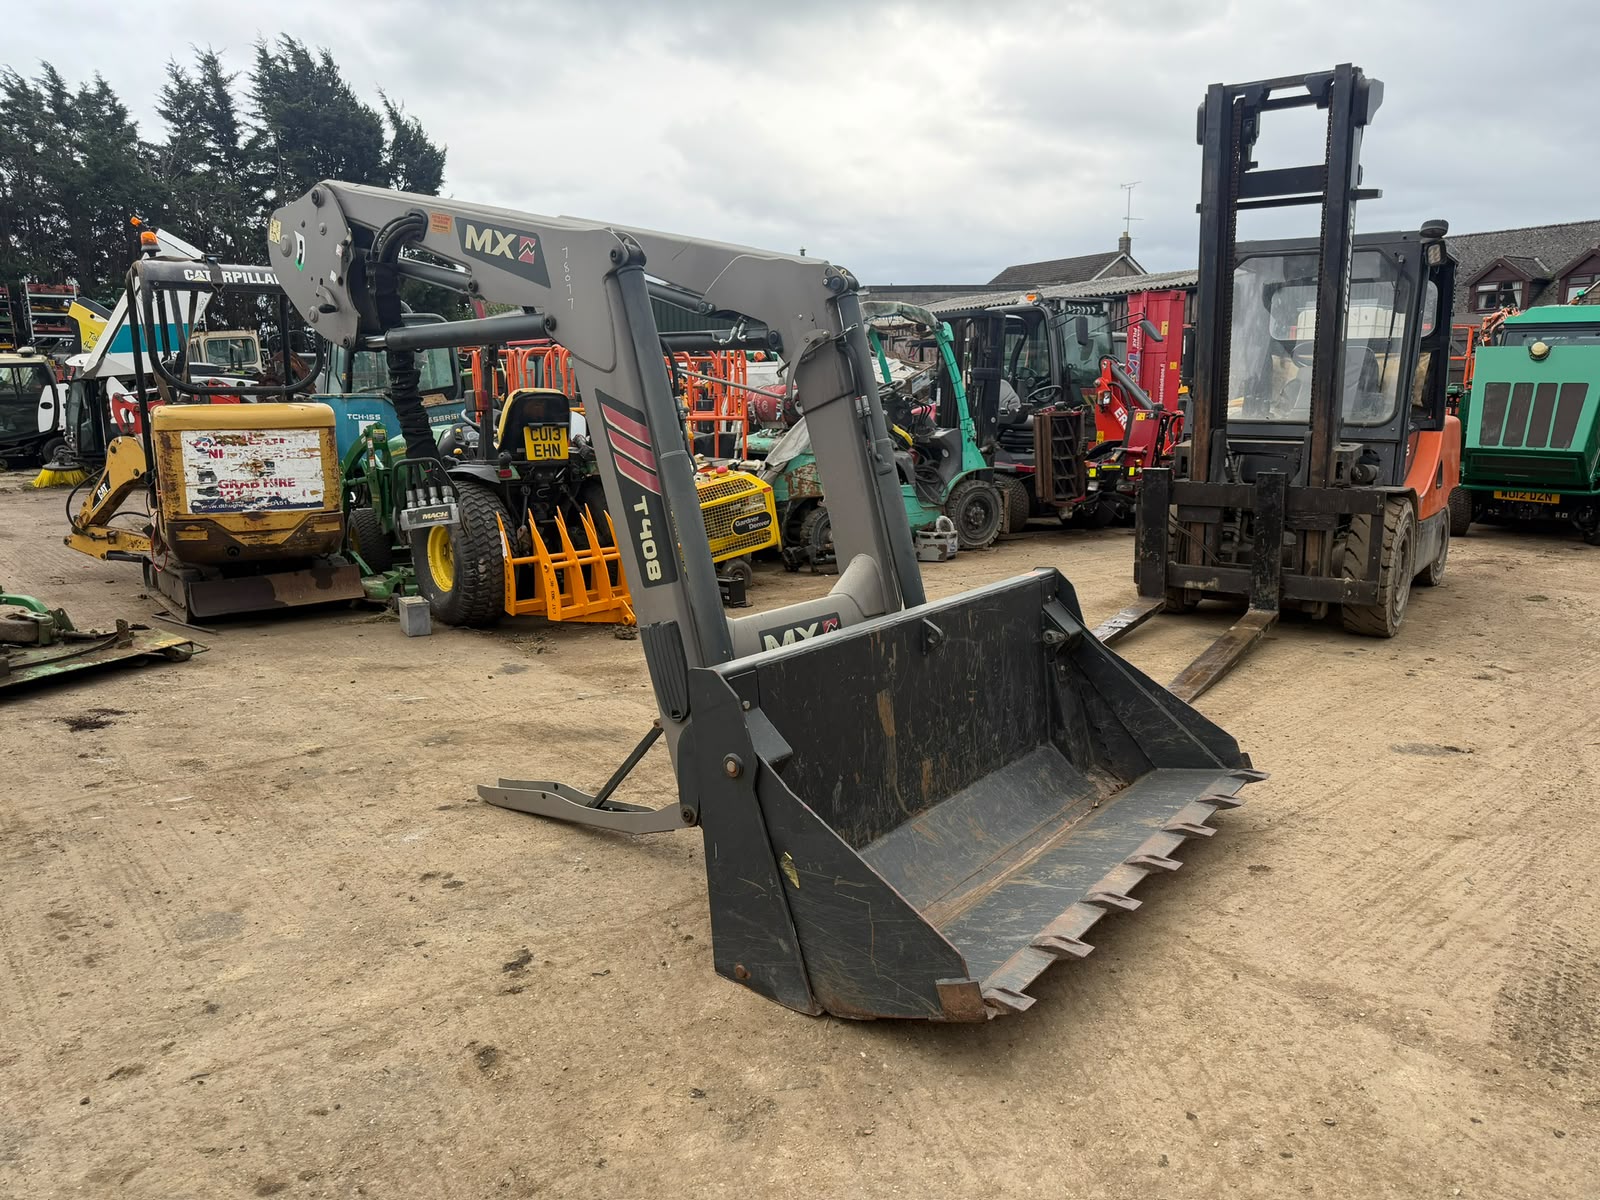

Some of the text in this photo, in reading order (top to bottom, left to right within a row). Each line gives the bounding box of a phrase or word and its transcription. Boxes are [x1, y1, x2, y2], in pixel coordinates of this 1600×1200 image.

[465, 224, 517, 260] MX
[1344, 207, 1355, 312] DOOSAN
[183, 269, 280, 285] CATRPILLA
[530, 427, 561, 442] CU13
[533, 443, 561, 458] EHN
[96, 482, 109, 501] CAT
[735, 516, 760, 527] Gardner
[748, 520, 770, 530] Denver
[633, 495, 662, 581] T408
